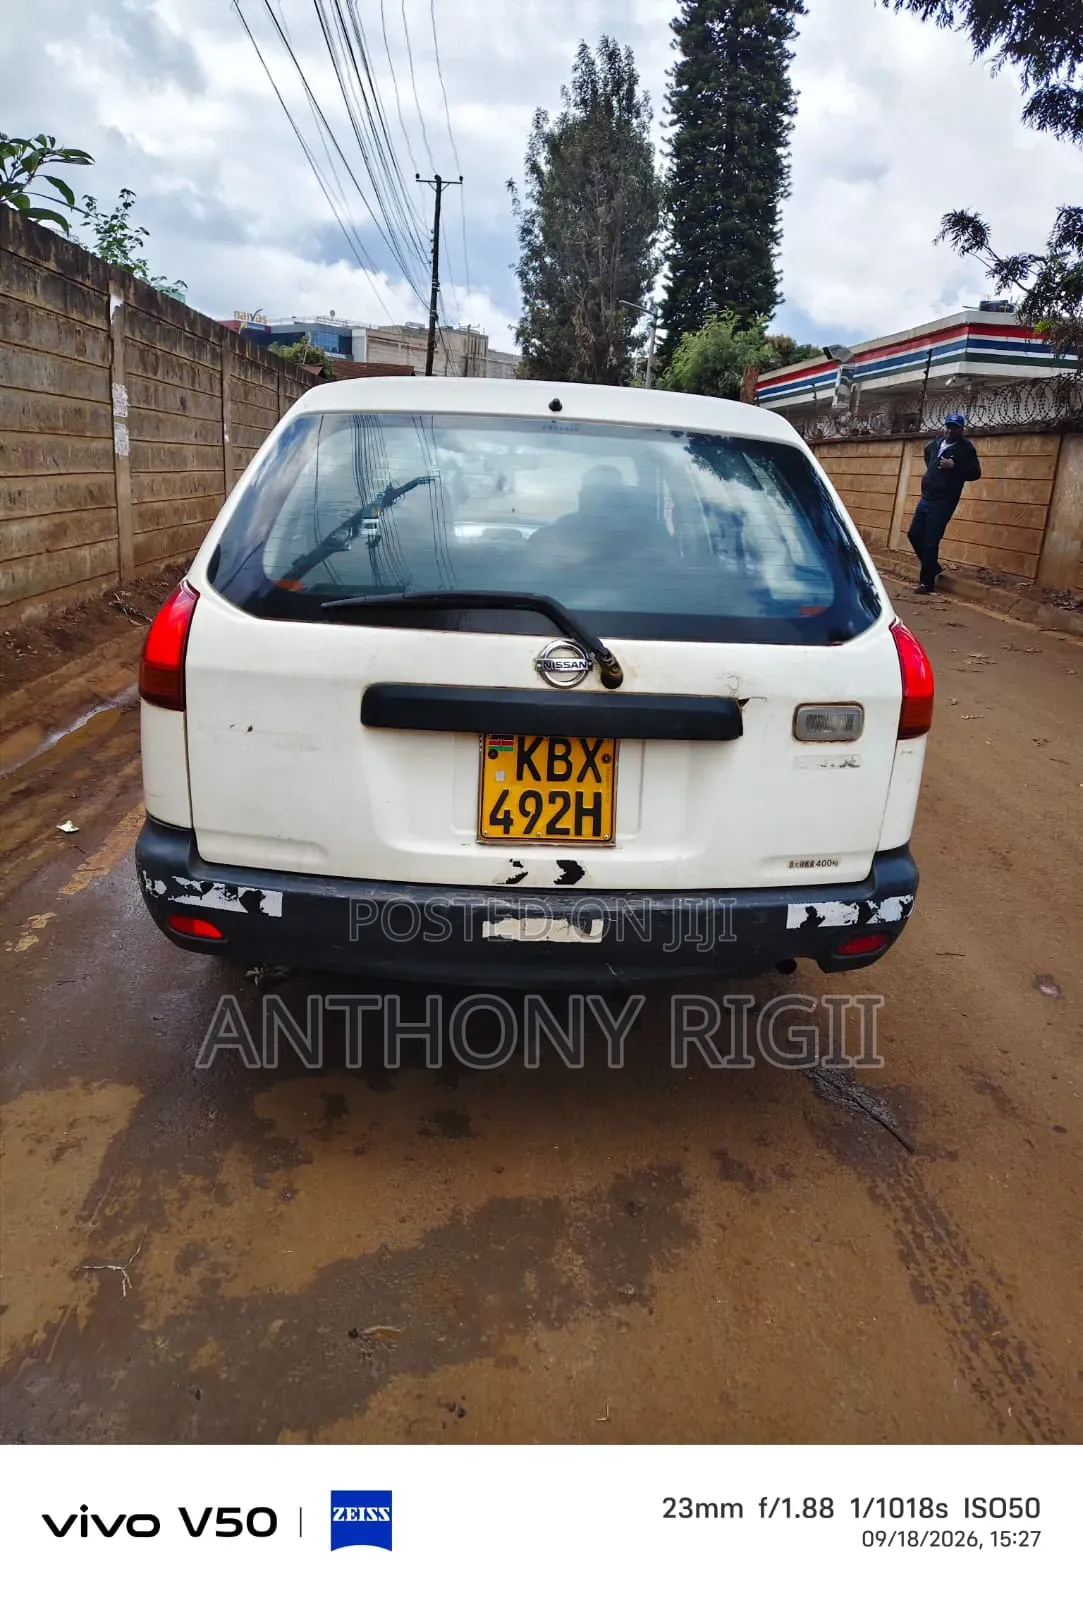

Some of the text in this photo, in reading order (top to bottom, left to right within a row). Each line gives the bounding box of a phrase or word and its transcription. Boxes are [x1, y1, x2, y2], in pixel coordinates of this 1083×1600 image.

[542, 660, 587, 669] NISSAN
[516, 736, 604, 783] KBX
[489, 789, 602, 836] 492H
